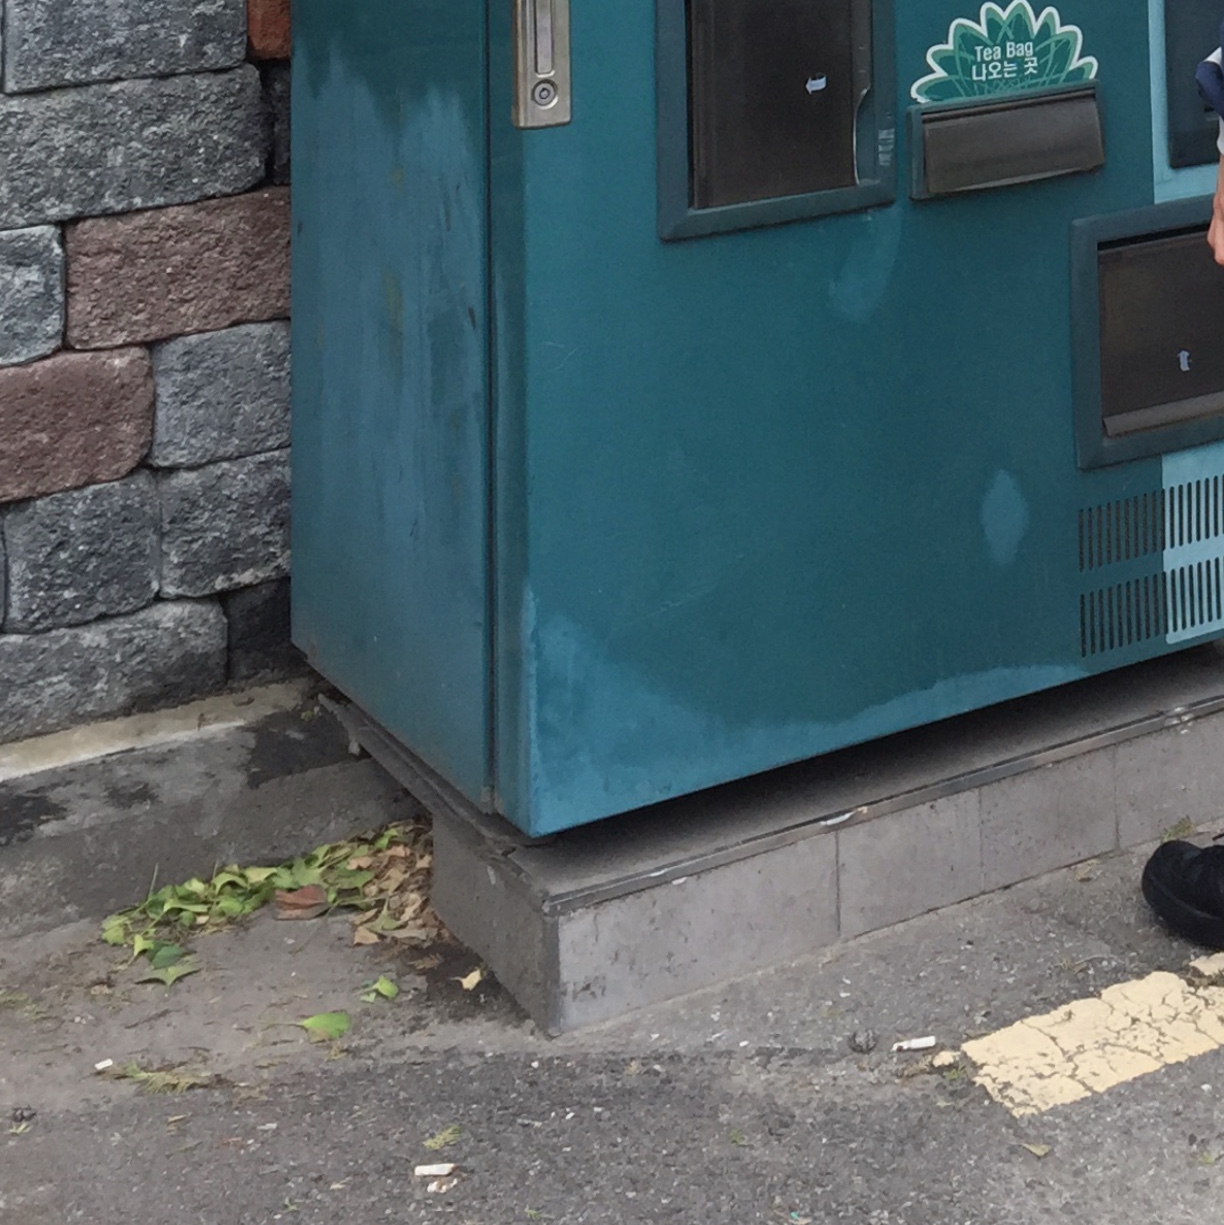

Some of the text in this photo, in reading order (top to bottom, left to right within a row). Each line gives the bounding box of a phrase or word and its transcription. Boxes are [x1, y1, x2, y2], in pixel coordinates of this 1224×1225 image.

[974, 41, 1033, 62] Tea Bag
[972, 57, 1038, 81] 나오는 곳
